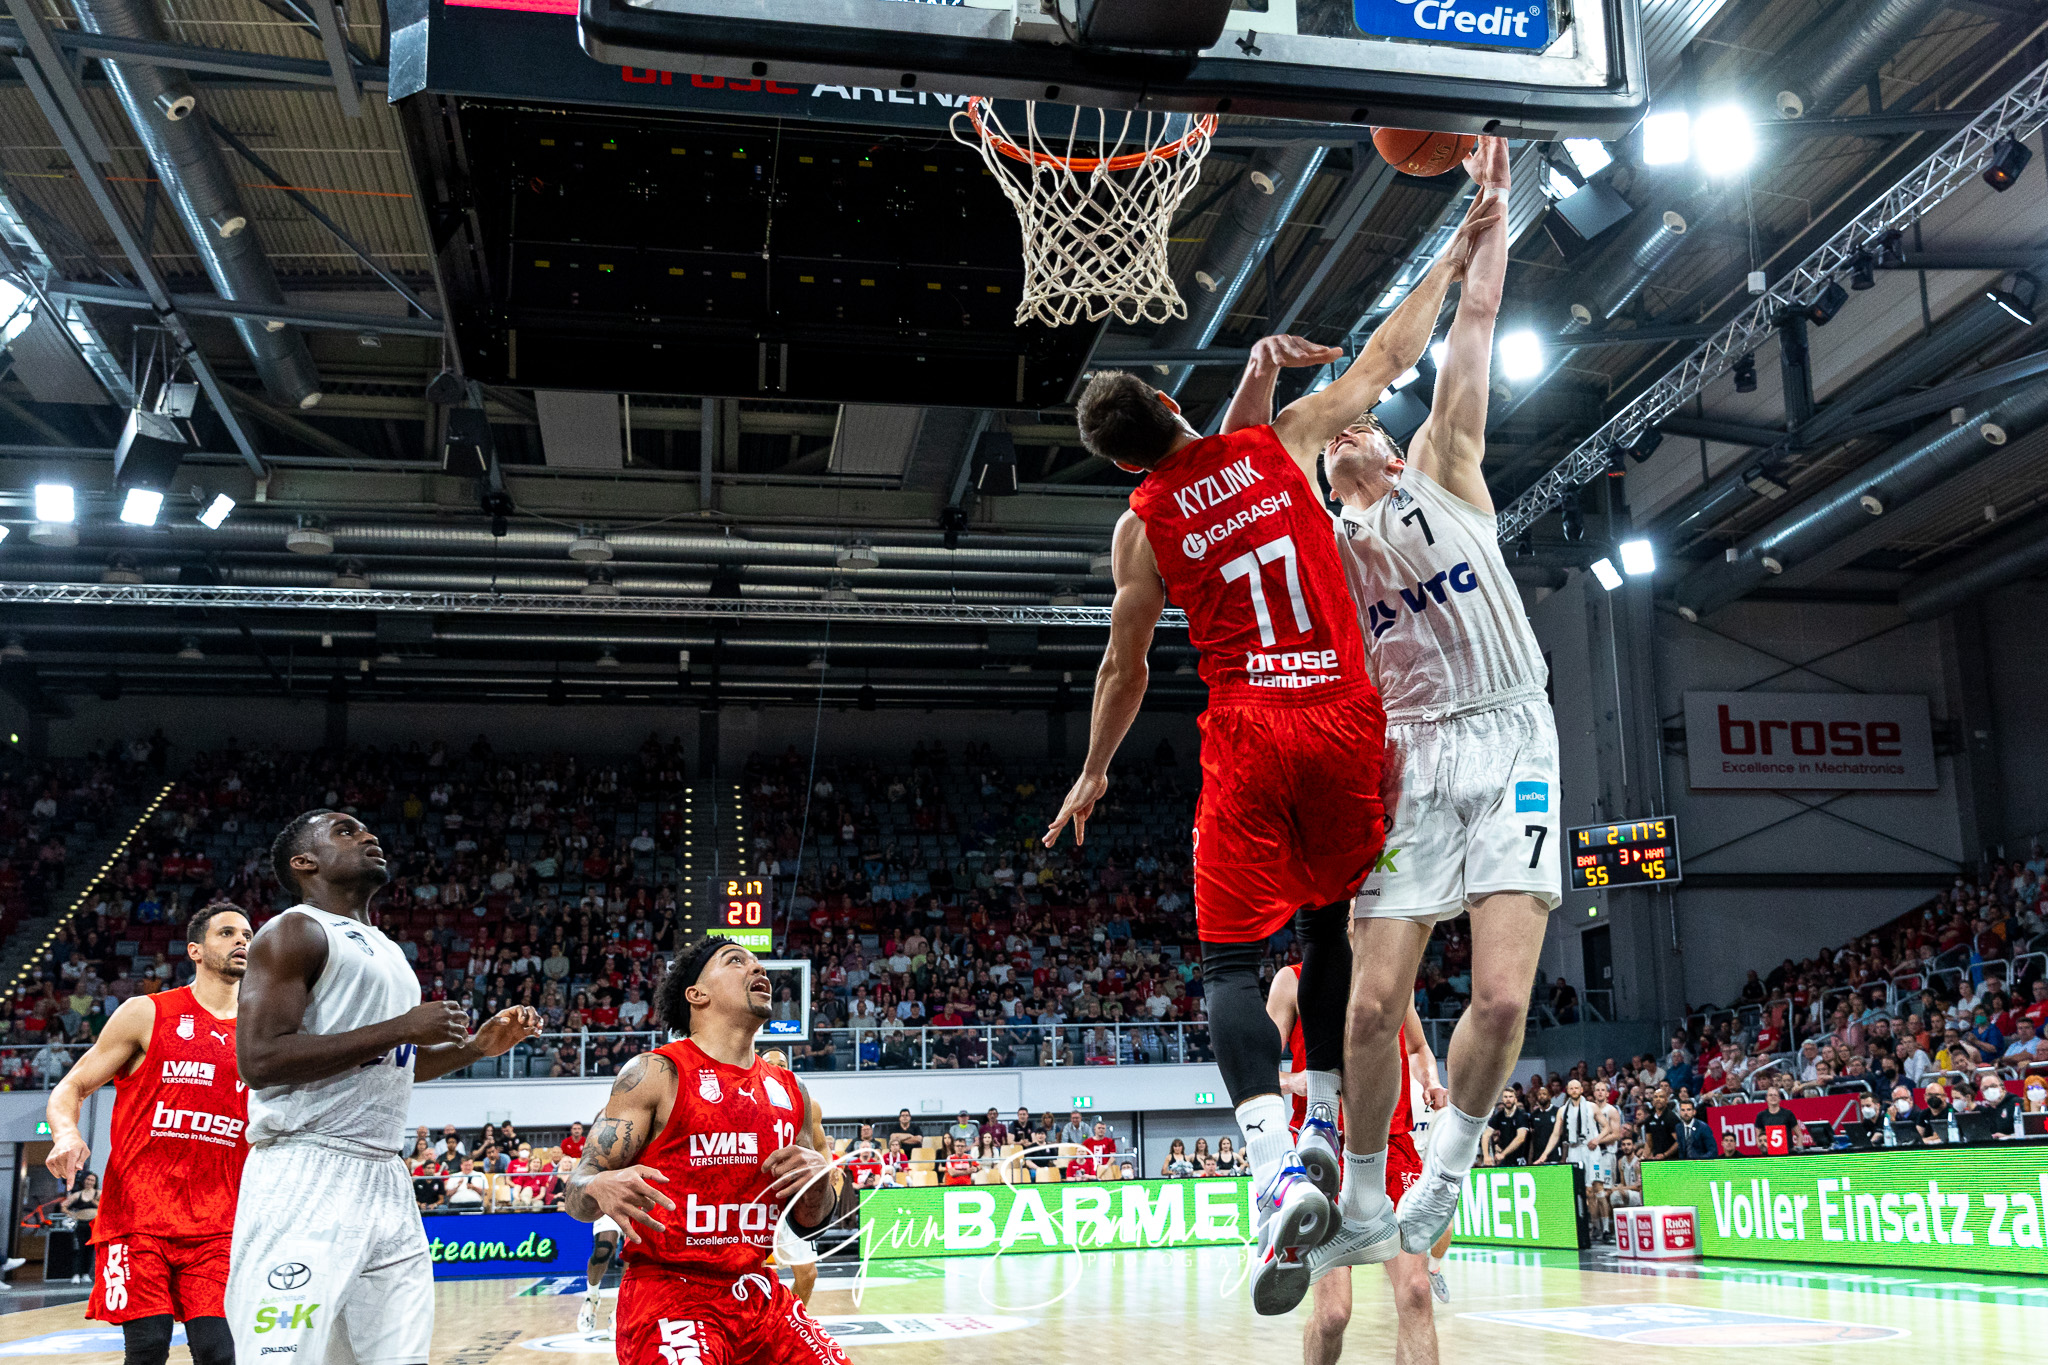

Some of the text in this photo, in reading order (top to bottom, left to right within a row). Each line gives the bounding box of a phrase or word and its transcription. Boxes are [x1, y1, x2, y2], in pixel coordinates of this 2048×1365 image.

[1173, 456, 1264, 519] KYZLINK
[1205, 491, 1292, 545] IGARASHI
[1401, 507, 1435, 546] 7
[1220, 535, 1312, 648] 77
[1399, 562, 1478, 613] VTG
[1246, 649, 1338, 673] brose
[1717, 705, 1902, 756] brose
[1722, 762, 1904, 774] Excellence in Mechatronics
[1525, 825, 1547, 869] 7
[1576, 847, 1665, 868] BAM 3 HAM
[1585, 859, 1666, 886] 55 45
[727, 901, 761, 925] 20
[162, 1060, 200, 1077] LVM
[162, 1077, 213, 1087] VERSICHERUNG
[152, 1101, 245, 1139] brose
[689, 1132, 737, 1157] LVM
[1770, 1129, 1783, 1147] 5
[689, 1155, 758, 1167] VERSICHERUNG
[1710, 1178, 1808, 1240] Voller
[1817, 1176, 1974, 1245] Einsatz
[686, 1236, 739, 1246] Excellence
[254, 1304, 321, 1334] S+K
